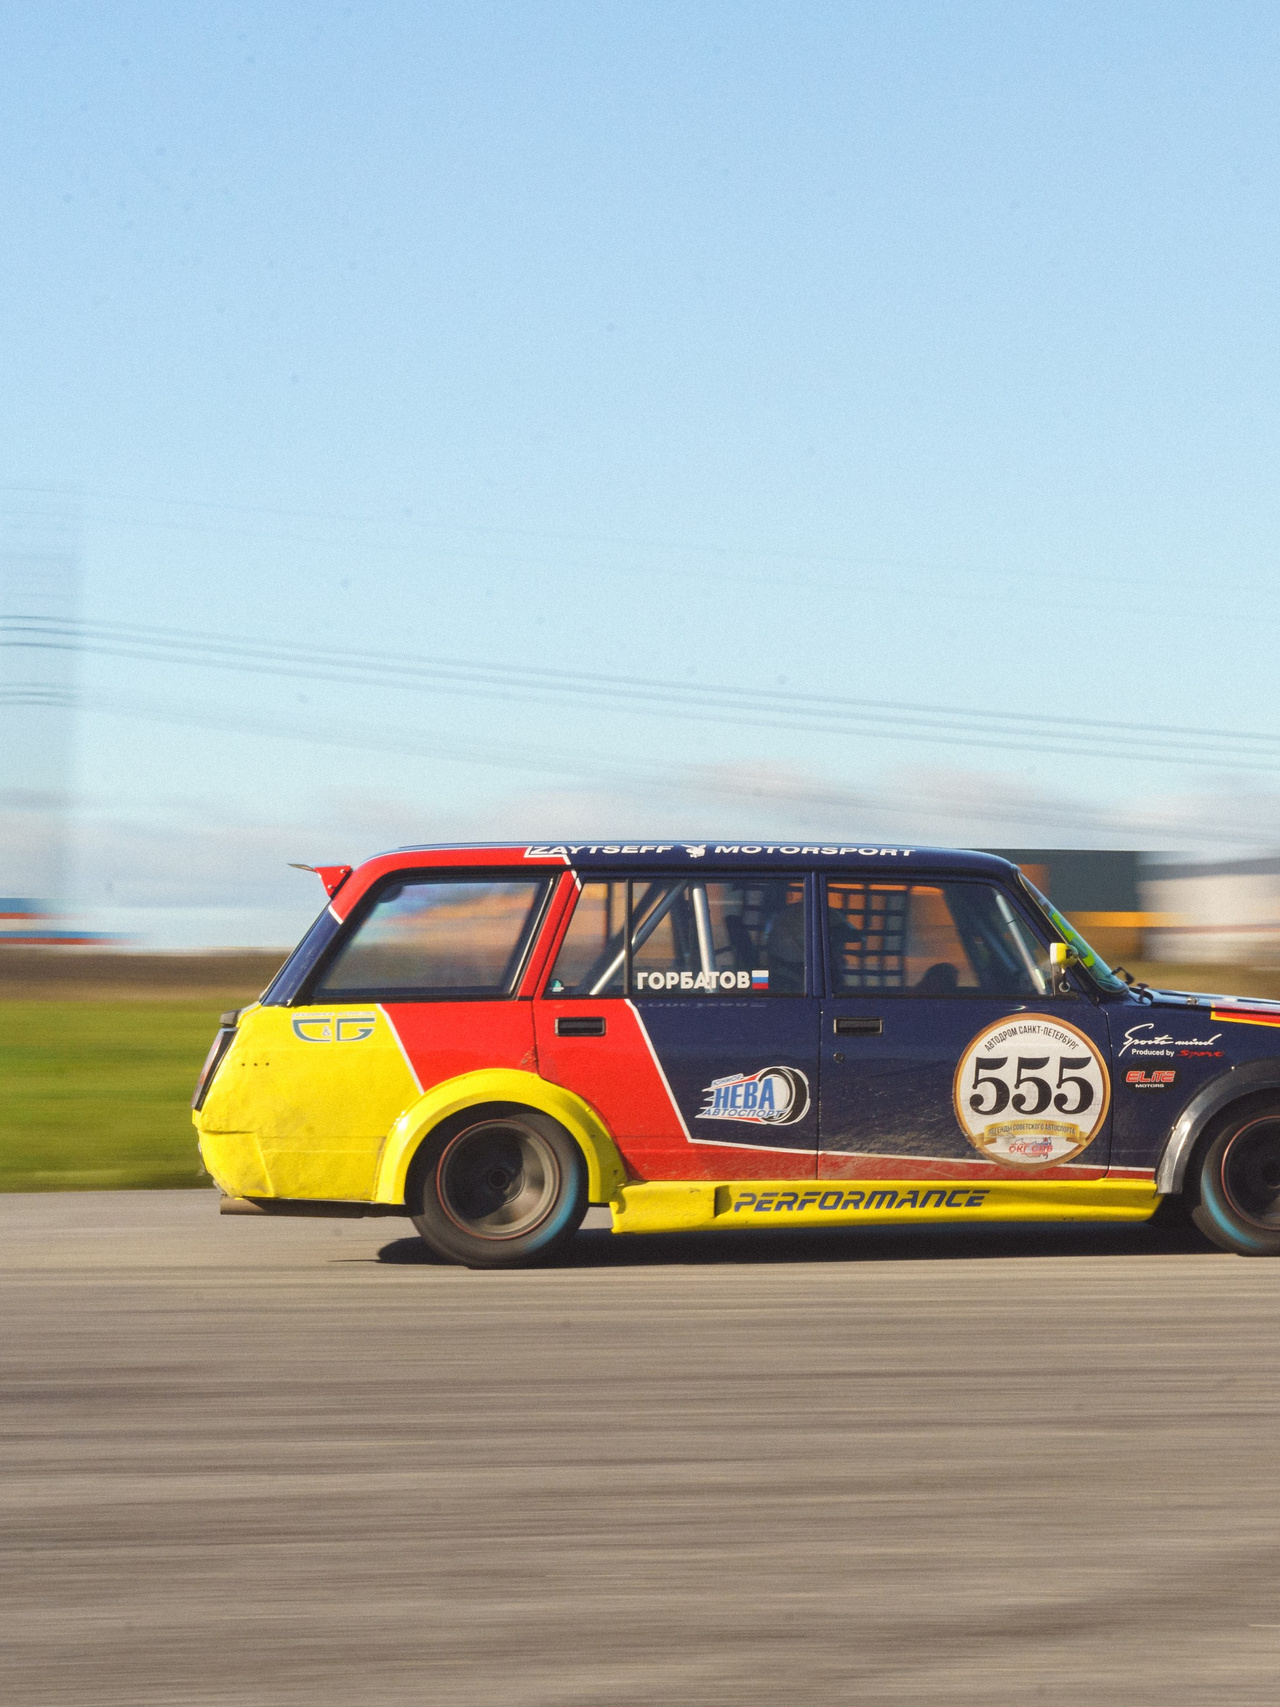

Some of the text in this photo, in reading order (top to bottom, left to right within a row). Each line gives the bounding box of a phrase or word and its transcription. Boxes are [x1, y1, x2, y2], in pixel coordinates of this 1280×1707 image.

[530, 845, 916, 857] ZAYTSEFF MOTORSPORT
[636, 971, 751, 990] ГОРБАТОВ
[984, 1025, 1080, 1052] АВТОДРОМ САНКТ-ПЕТЕРБУРГ
[1131, 1048, 1165, 1056] Produced
[1165, 1049, 1175, 1057] by
[713, 1077, 775, 1110] НЕВА
[969, 1056, 1094, 1116] 555
[703, 1108, 787, 1119] АВТОСПОРТ
[733, 1189, 991, 1213] PERFORMANCE
